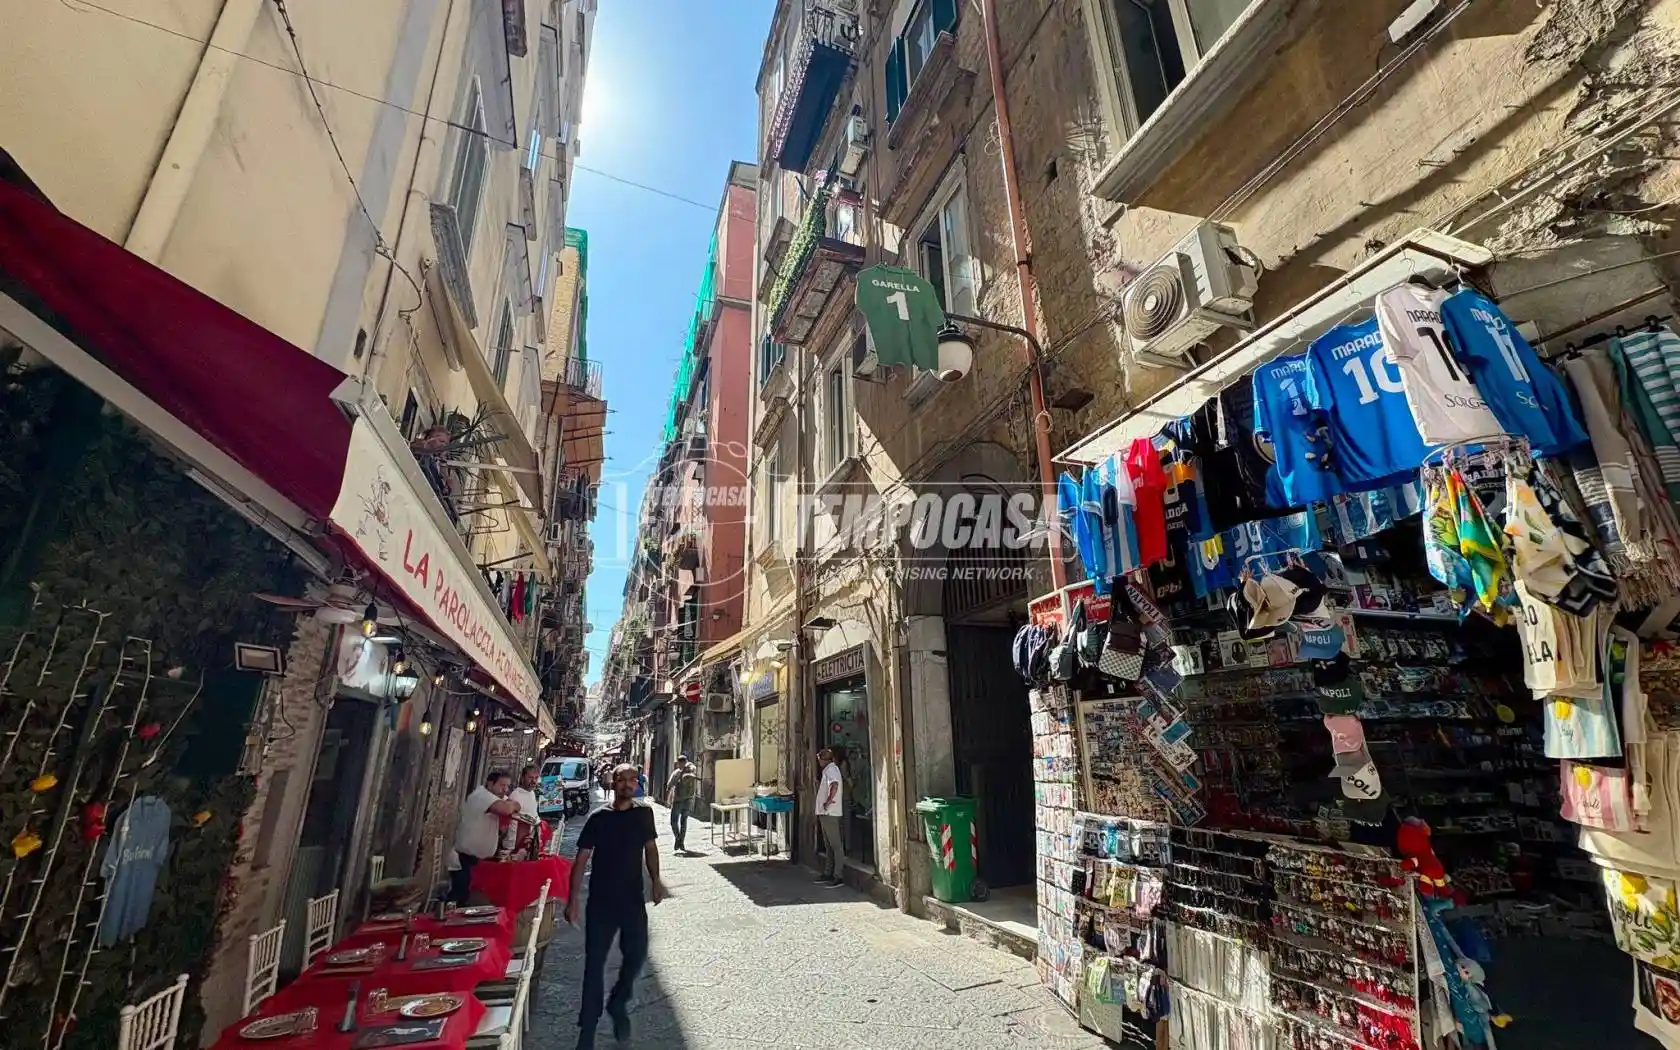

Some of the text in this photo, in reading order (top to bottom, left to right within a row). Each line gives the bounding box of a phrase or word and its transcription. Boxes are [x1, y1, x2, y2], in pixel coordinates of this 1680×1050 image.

[871, 279, 920, 293] GARELLA
[886, 291, 910, 321] 1
[403, 528, 495, 663] LA PAROLACCIA
[1127, 586, 1161, 618] NAPOLI
[1304, 633, 1332, 645] NAPOLI
[1320, 686, 1352, 698] NAPOLI
